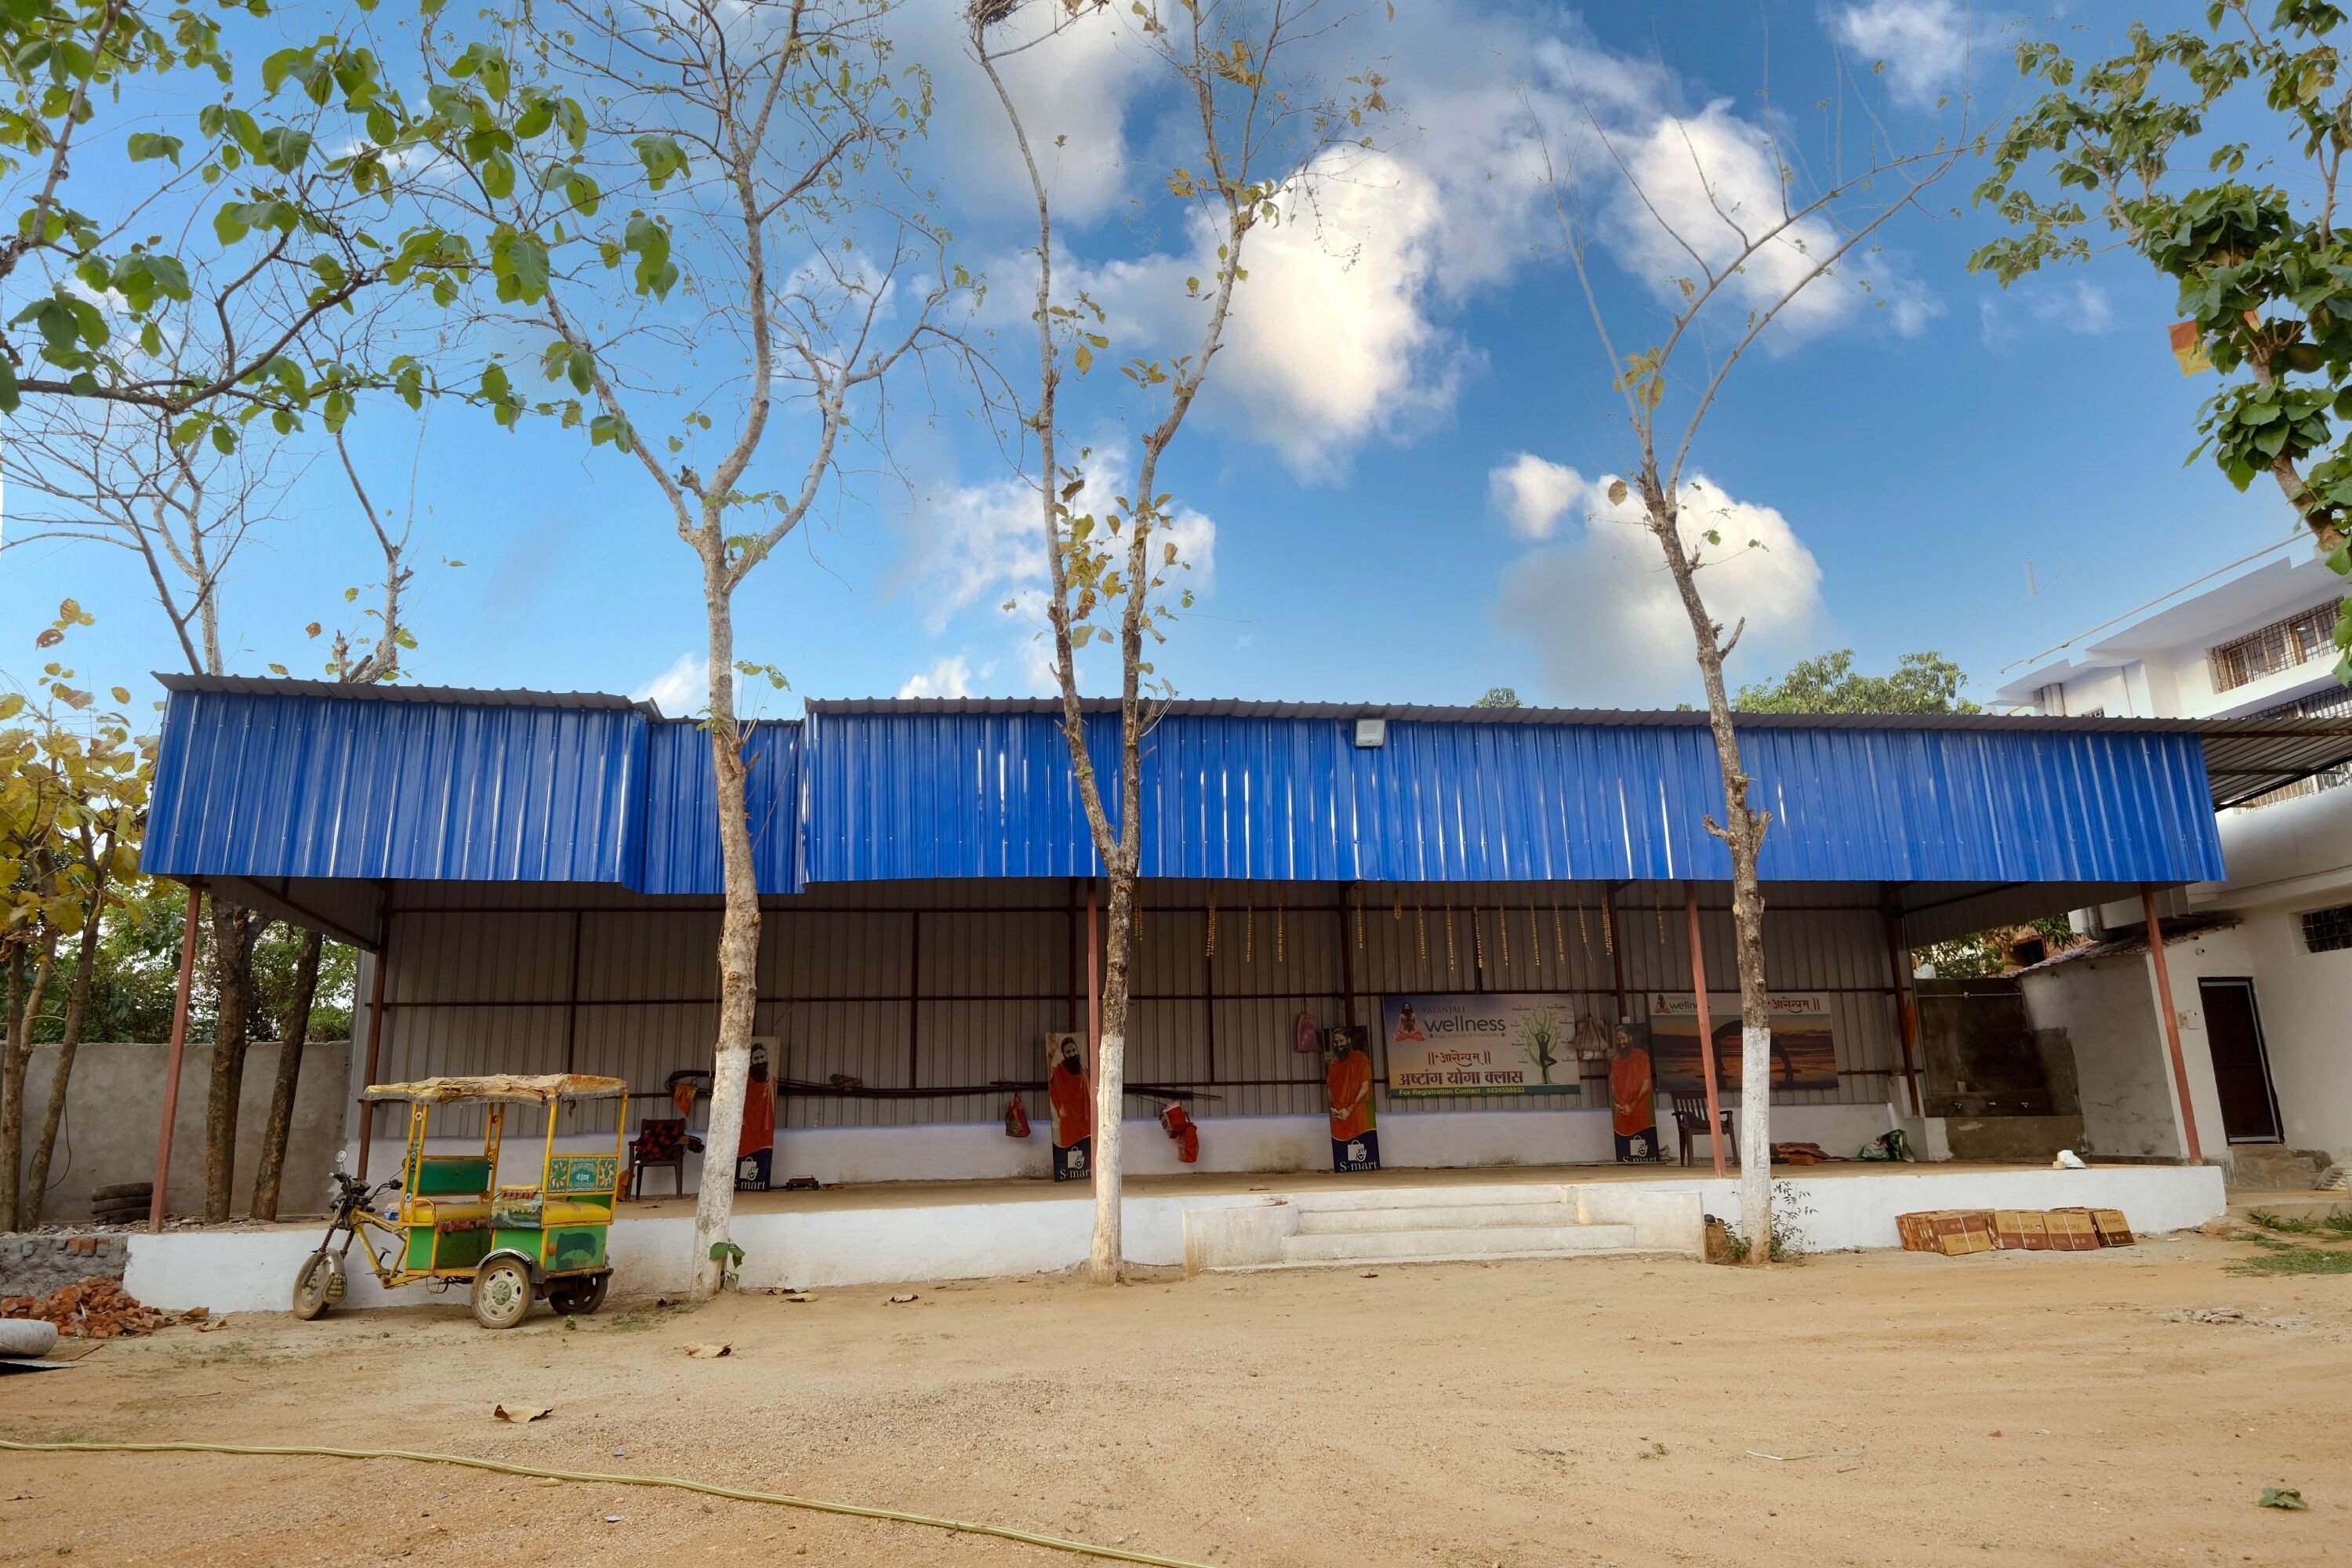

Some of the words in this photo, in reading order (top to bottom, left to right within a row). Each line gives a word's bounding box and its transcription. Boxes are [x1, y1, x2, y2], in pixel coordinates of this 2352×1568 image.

[1423, 1005, 1465, 1014] PATANJALI
[1423, 1015, 1506, 1033] wellness
[1399, 1069, 1443, 1086] अष्टांग
[1446, 1068, 1480, 1084] योगा
[1484, 1071, 1523, 1083] क्लास
[1412, 1088, 1454, 1097] Registration
[1340, 1160, 1377, 1172] S-mart
